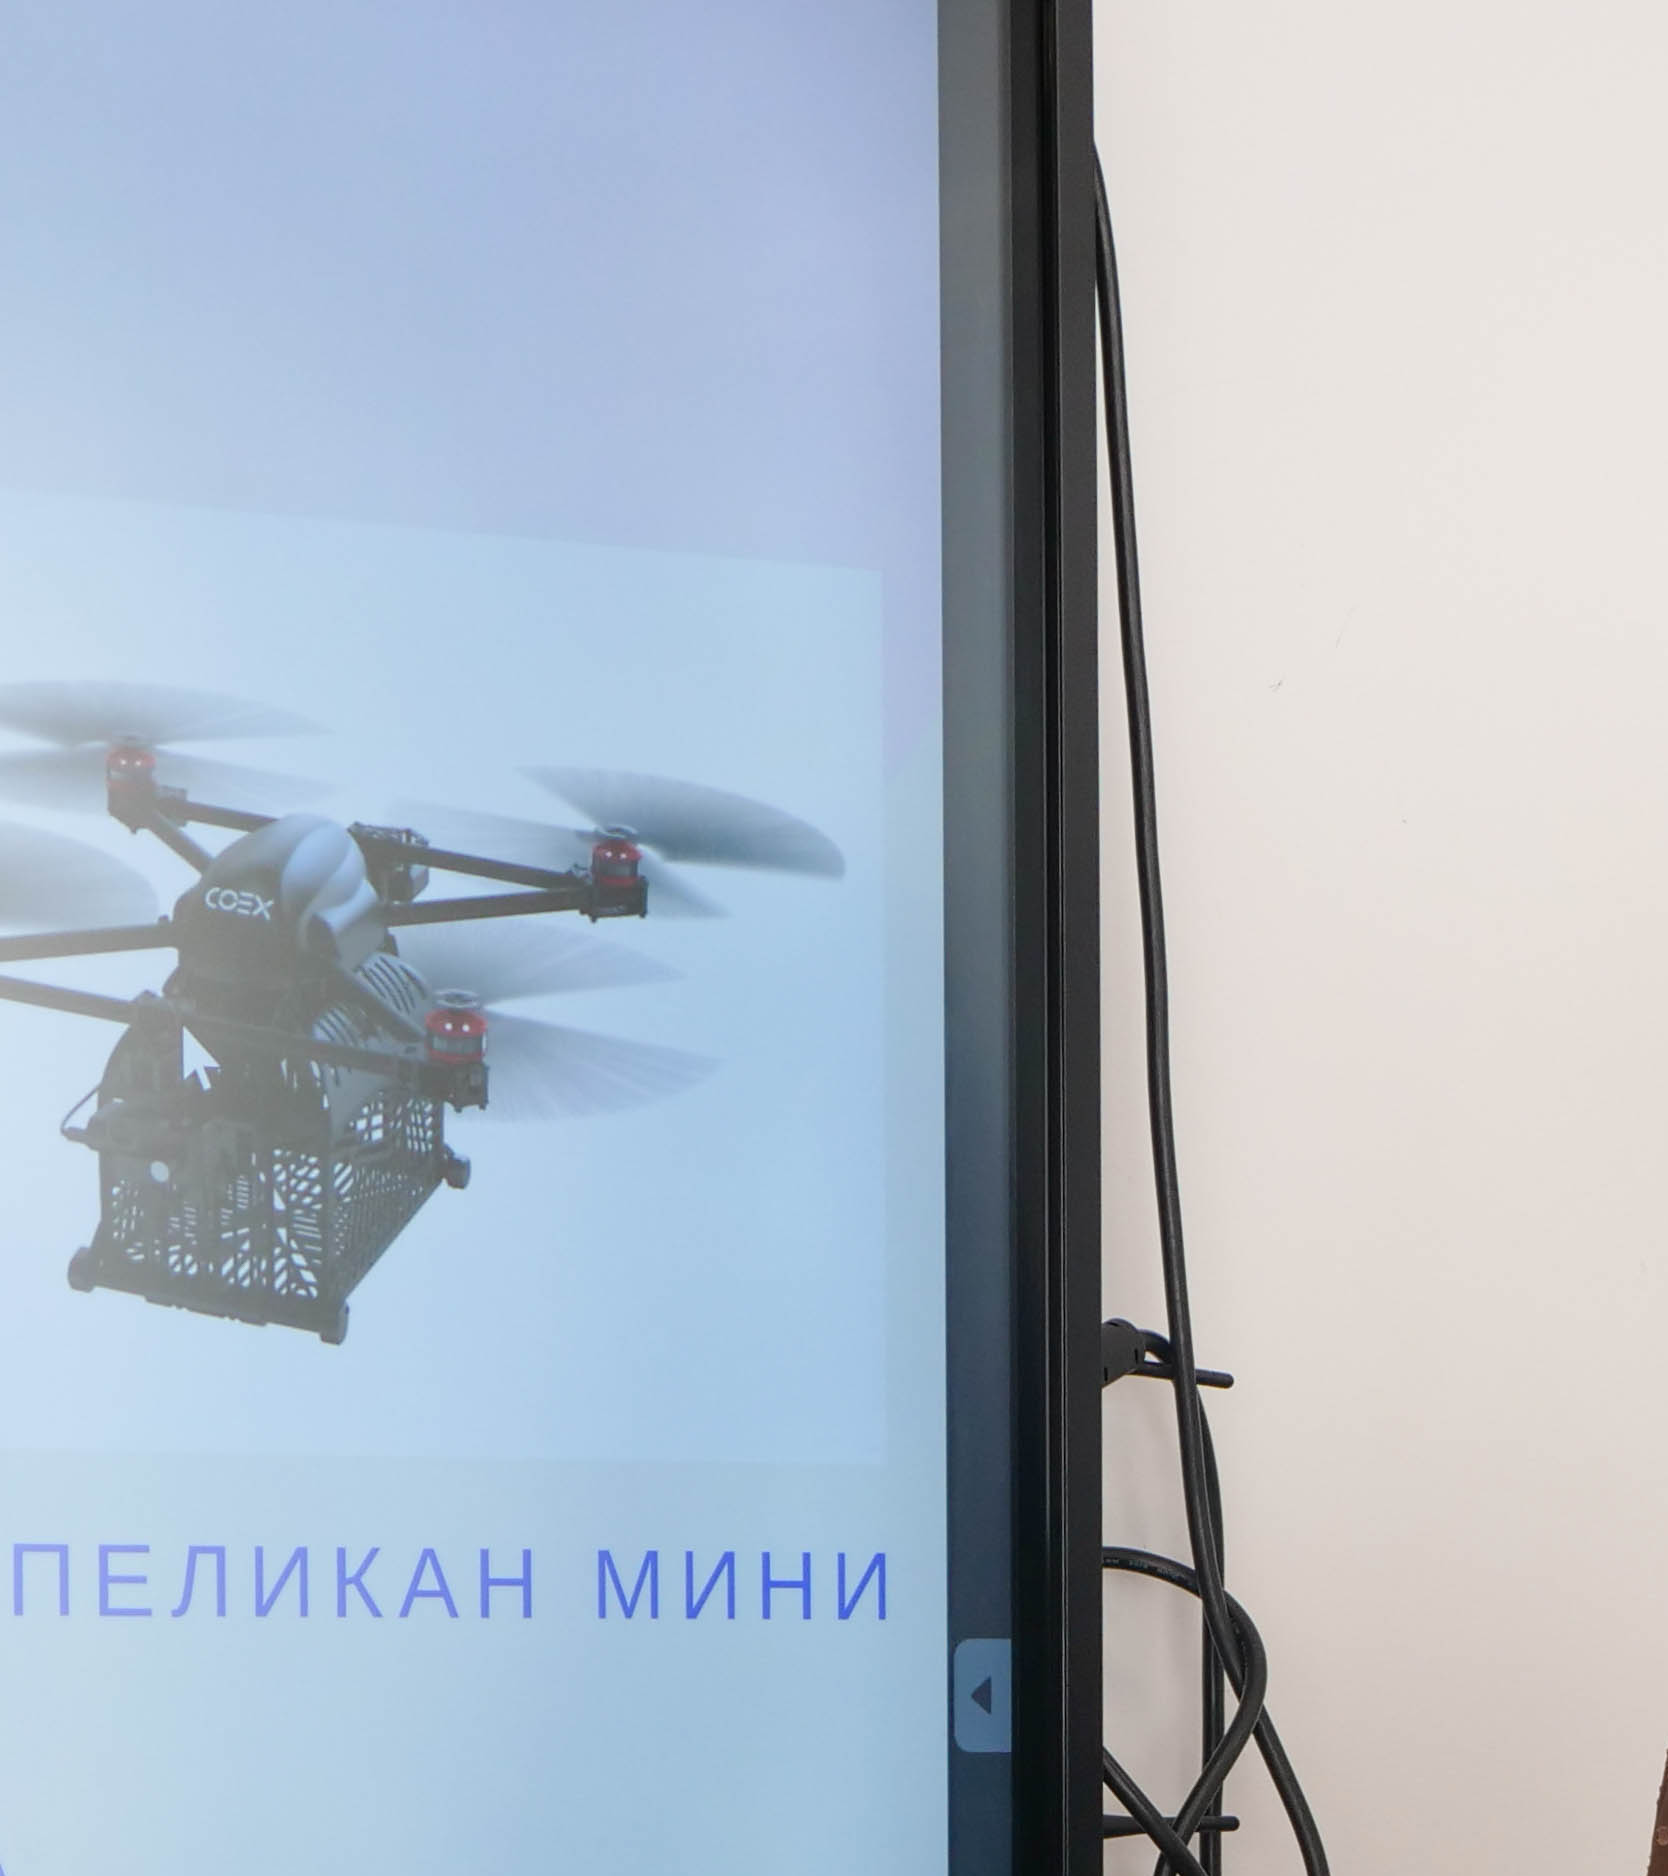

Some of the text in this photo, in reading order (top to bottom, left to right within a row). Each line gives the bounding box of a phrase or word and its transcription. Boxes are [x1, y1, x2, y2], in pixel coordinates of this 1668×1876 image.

[205, 887, 274, 921] COEX
[12, 1542, 890, 1622] ПЕЛИКАН МИНИ
